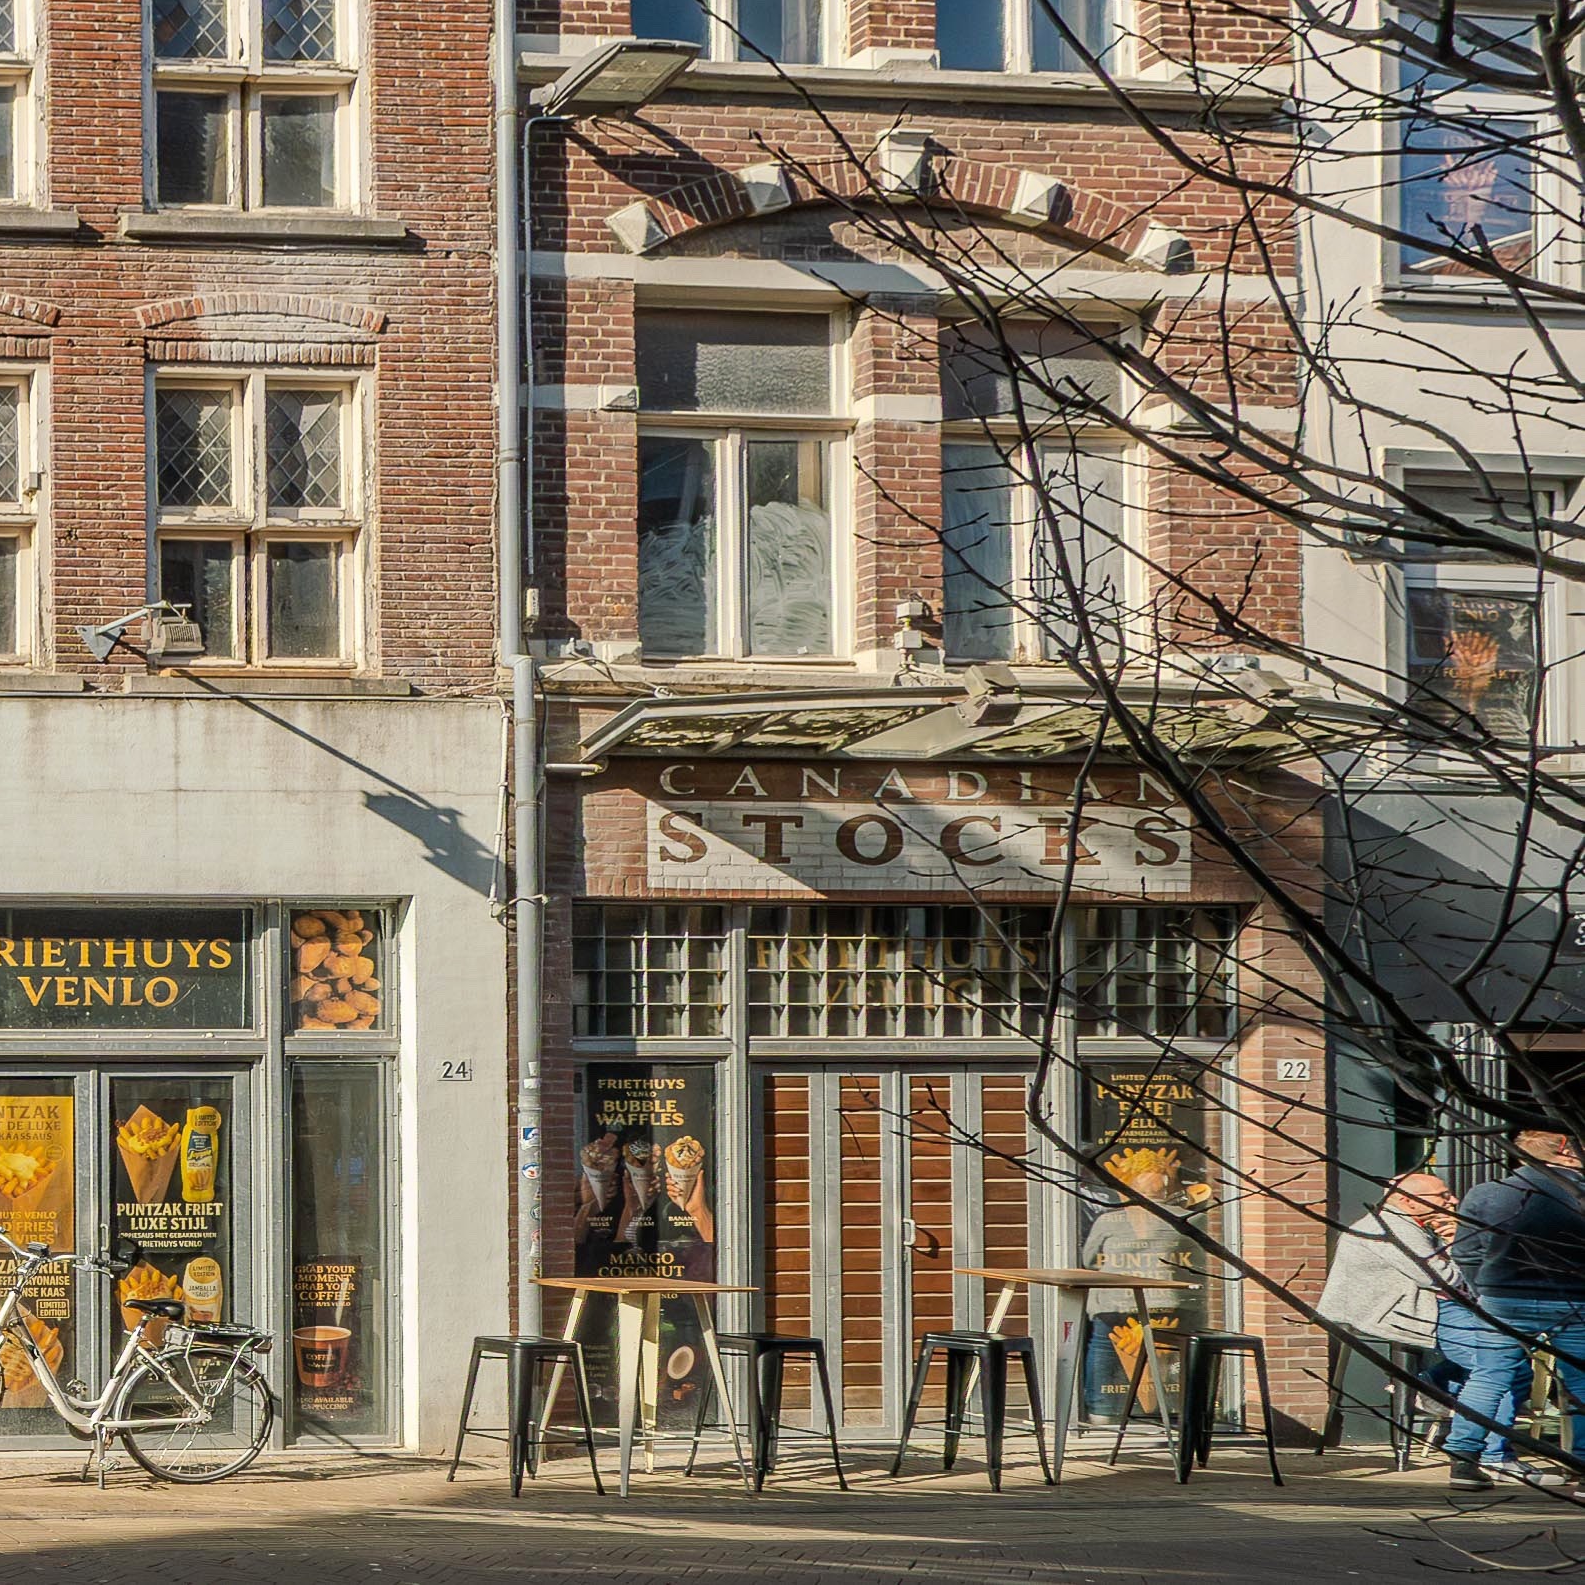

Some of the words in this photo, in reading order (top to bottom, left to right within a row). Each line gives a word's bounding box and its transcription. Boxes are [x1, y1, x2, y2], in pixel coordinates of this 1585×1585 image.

[659, 764, 1177, 802] CANADIAN
[659, 812, 1181, 867] STOCKS
[17, 976, 179, 1007] VENLO
[442, 1061, 468, 1078] 24
[1283, 1062, 1306, 1078] 22
[597, 1078, 686, 1090] FRIETHUYS
[603, 1099, 677, 1113] BUBBLE
[596, 1113, 685, 1126] WAFFLES
[7, 1121, 23, 1131] DE
[28, 1121, 62, 1131] LUXE
[24, 1211, 57, 1220] VENLO
[116, 1203, 182, 1216] PUNTZAK
[185, 1203, 223, 1216] FRIET
[131, 1217, 168, 1230] LUXE
[170, 1217, 208, 1230] STIJL
[609, 1252, 674, 1264] MANGO
[42, 1259, 70, 1274] RIET
[295, 1265, 323, 1273] GRAB
[326, 1265, 355, 1273] YOUR
[598, 1265, 685, 1277] COCONUT
[40, 1288, 65, 1298] KAAS
[294, 1283, 324, 1291] GRAB
[299, 1291, 351, 1300] COFFEE
[39, 1301, 66, 1309] LIMITED
